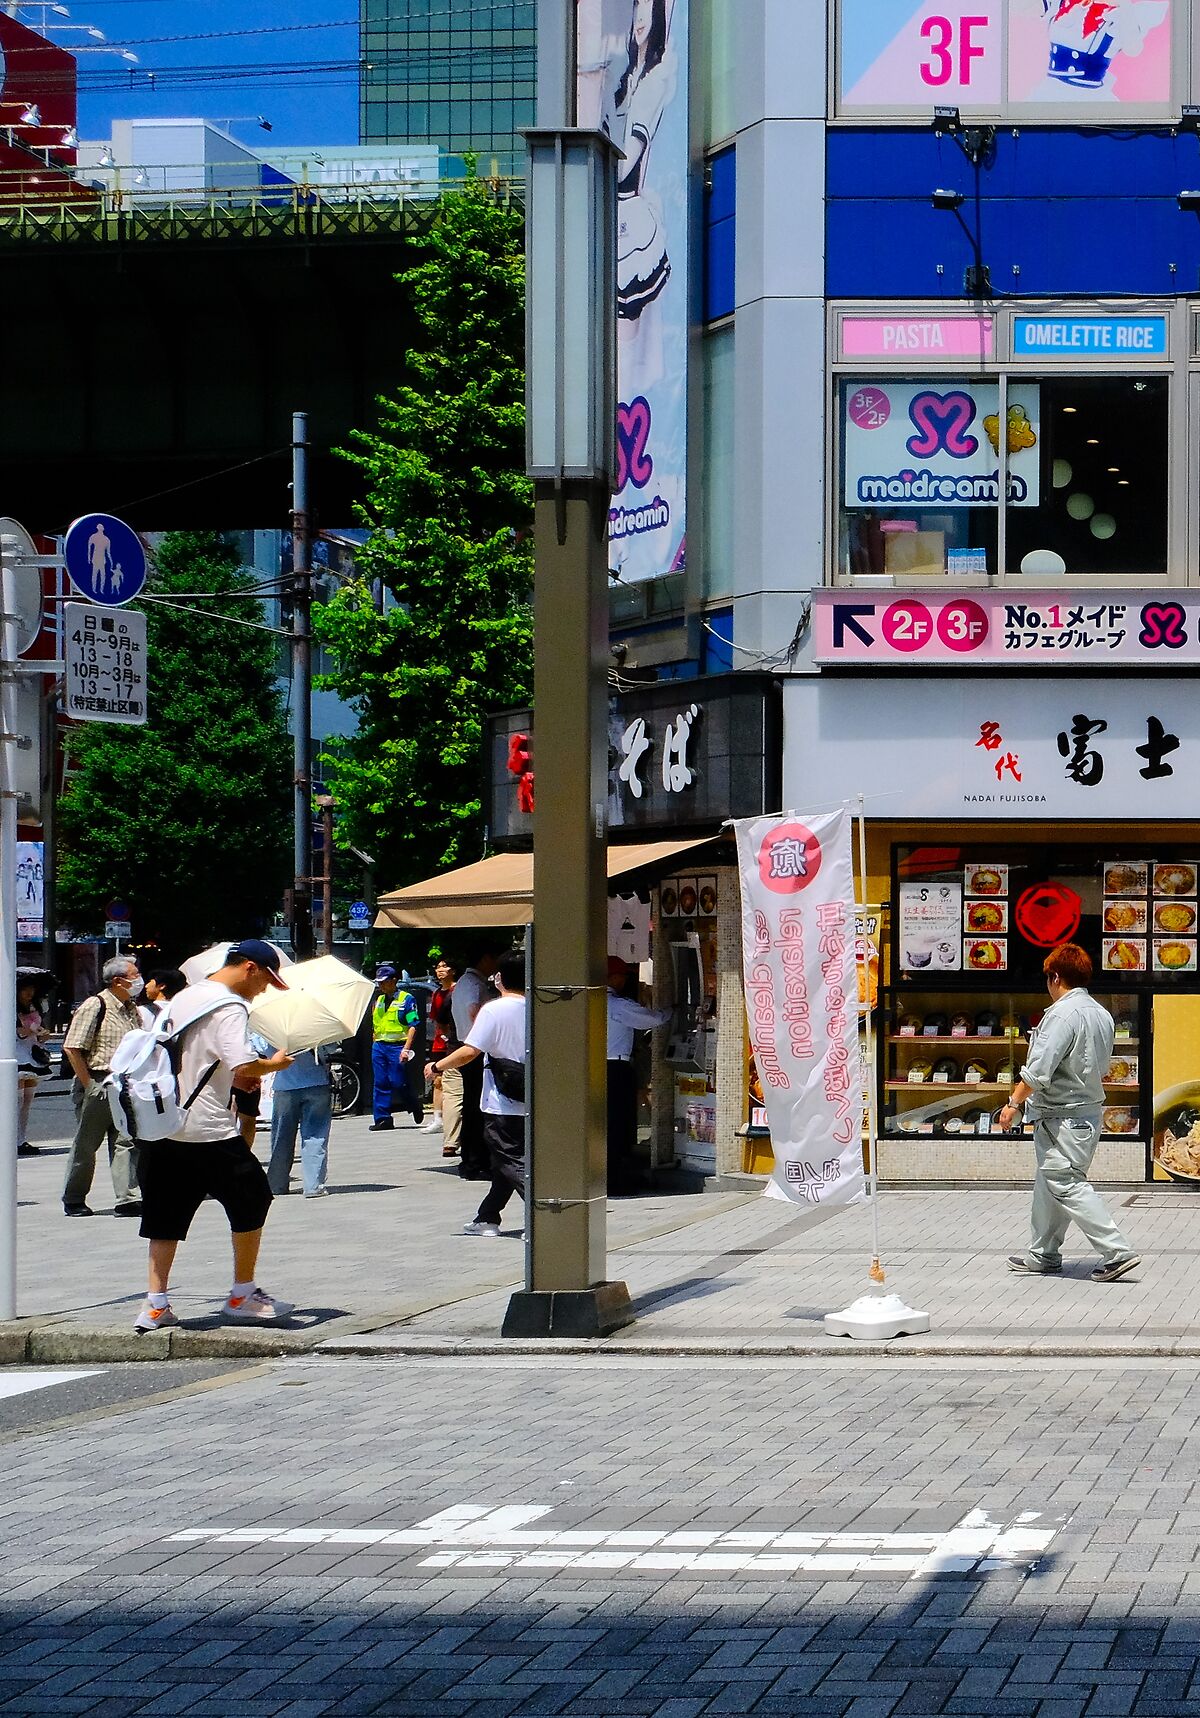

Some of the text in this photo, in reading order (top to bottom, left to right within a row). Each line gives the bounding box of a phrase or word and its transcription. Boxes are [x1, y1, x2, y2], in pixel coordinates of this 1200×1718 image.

[919, 15, 989, 87] 3F
[882, 323, 944, 350] PASTA
[1025, 324, 1154, 350] OMELETTE RICE
[855, 393, 873, 409] 3F
[868, 410, 886, 425] 2F
[860, 471, 1024, 499] maidreamn
[608, 498, 668, 537] idreamin
[892, 610, 982, 640] 2F 3F
[1004, 605, 1127, 629] No.1メイド
[1004, 630, 1127, 650] カフェグループ
[975, 720, 1023, 783] 名代
[999, 795, 1048, 803] FUJISOBA
